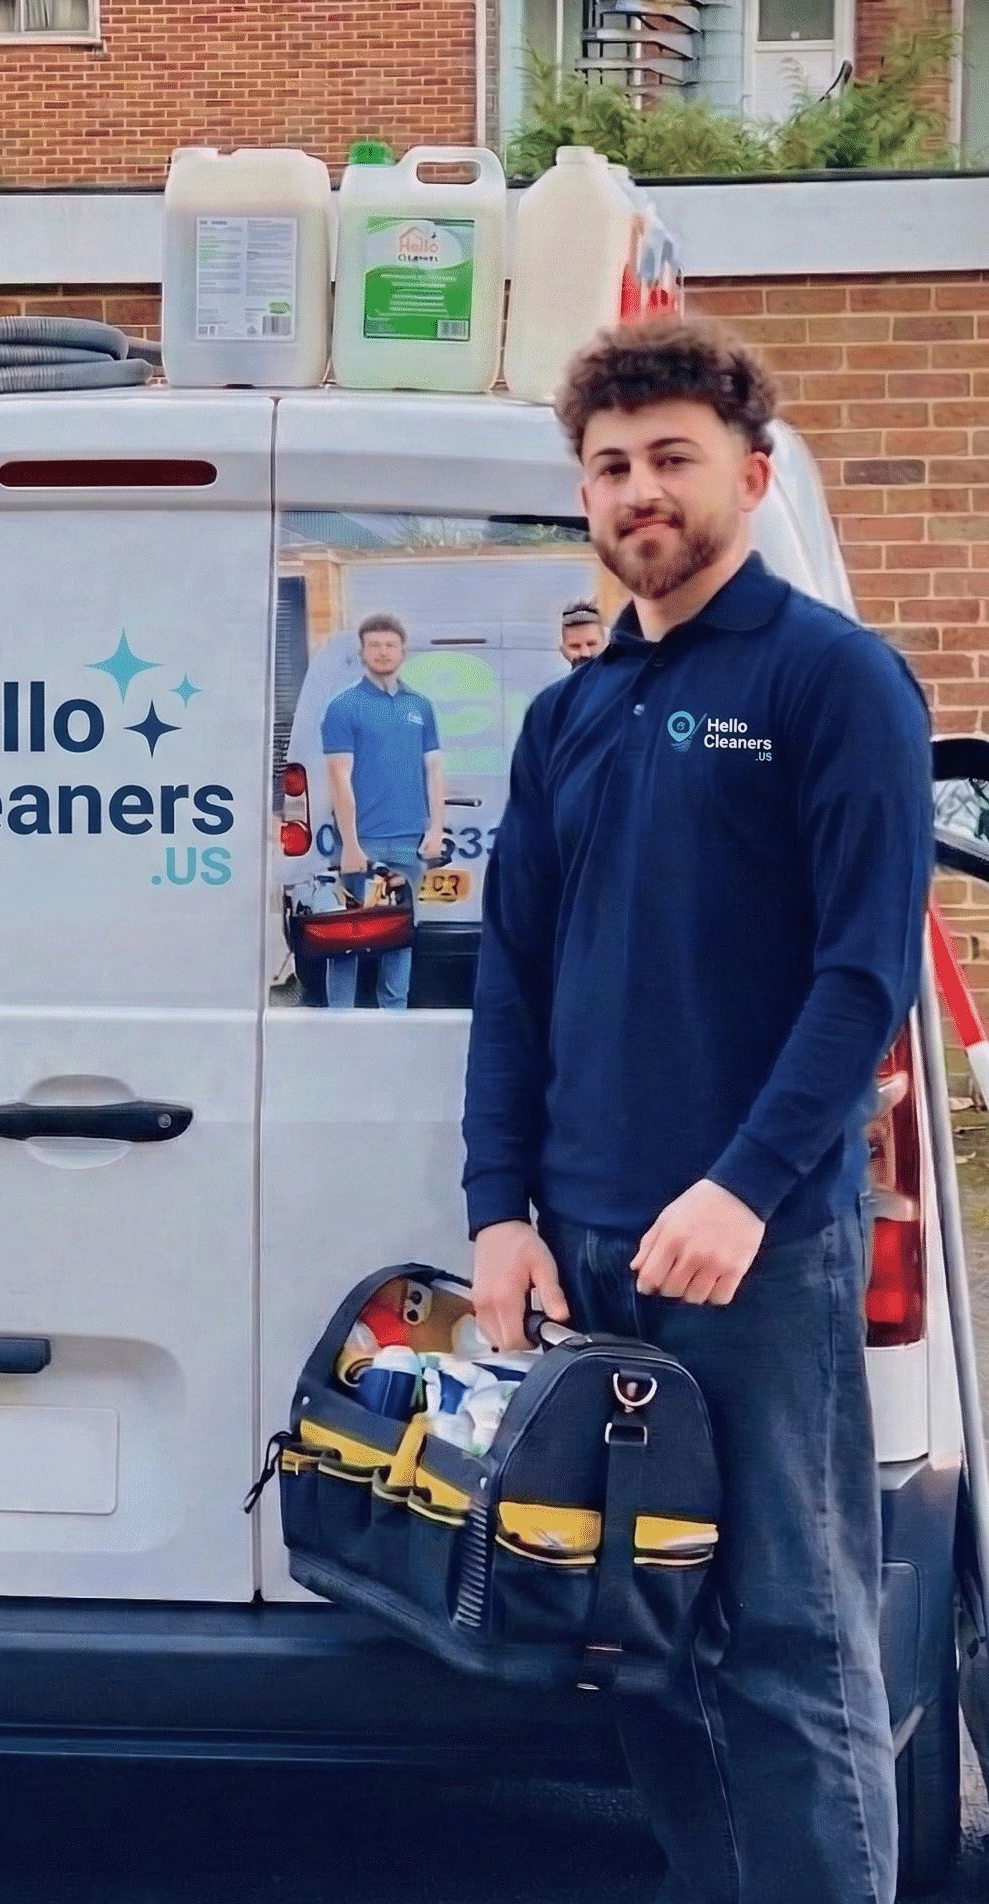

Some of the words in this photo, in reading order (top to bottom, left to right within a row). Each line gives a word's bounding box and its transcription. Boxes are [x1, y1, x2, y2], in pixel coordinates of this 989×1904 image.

[707, 718, 748, 733] Hello
[703, 734, 772, 750] Cleaners
[755, 751, 772, 762] .US
[150, 846, 233, 887] .US
